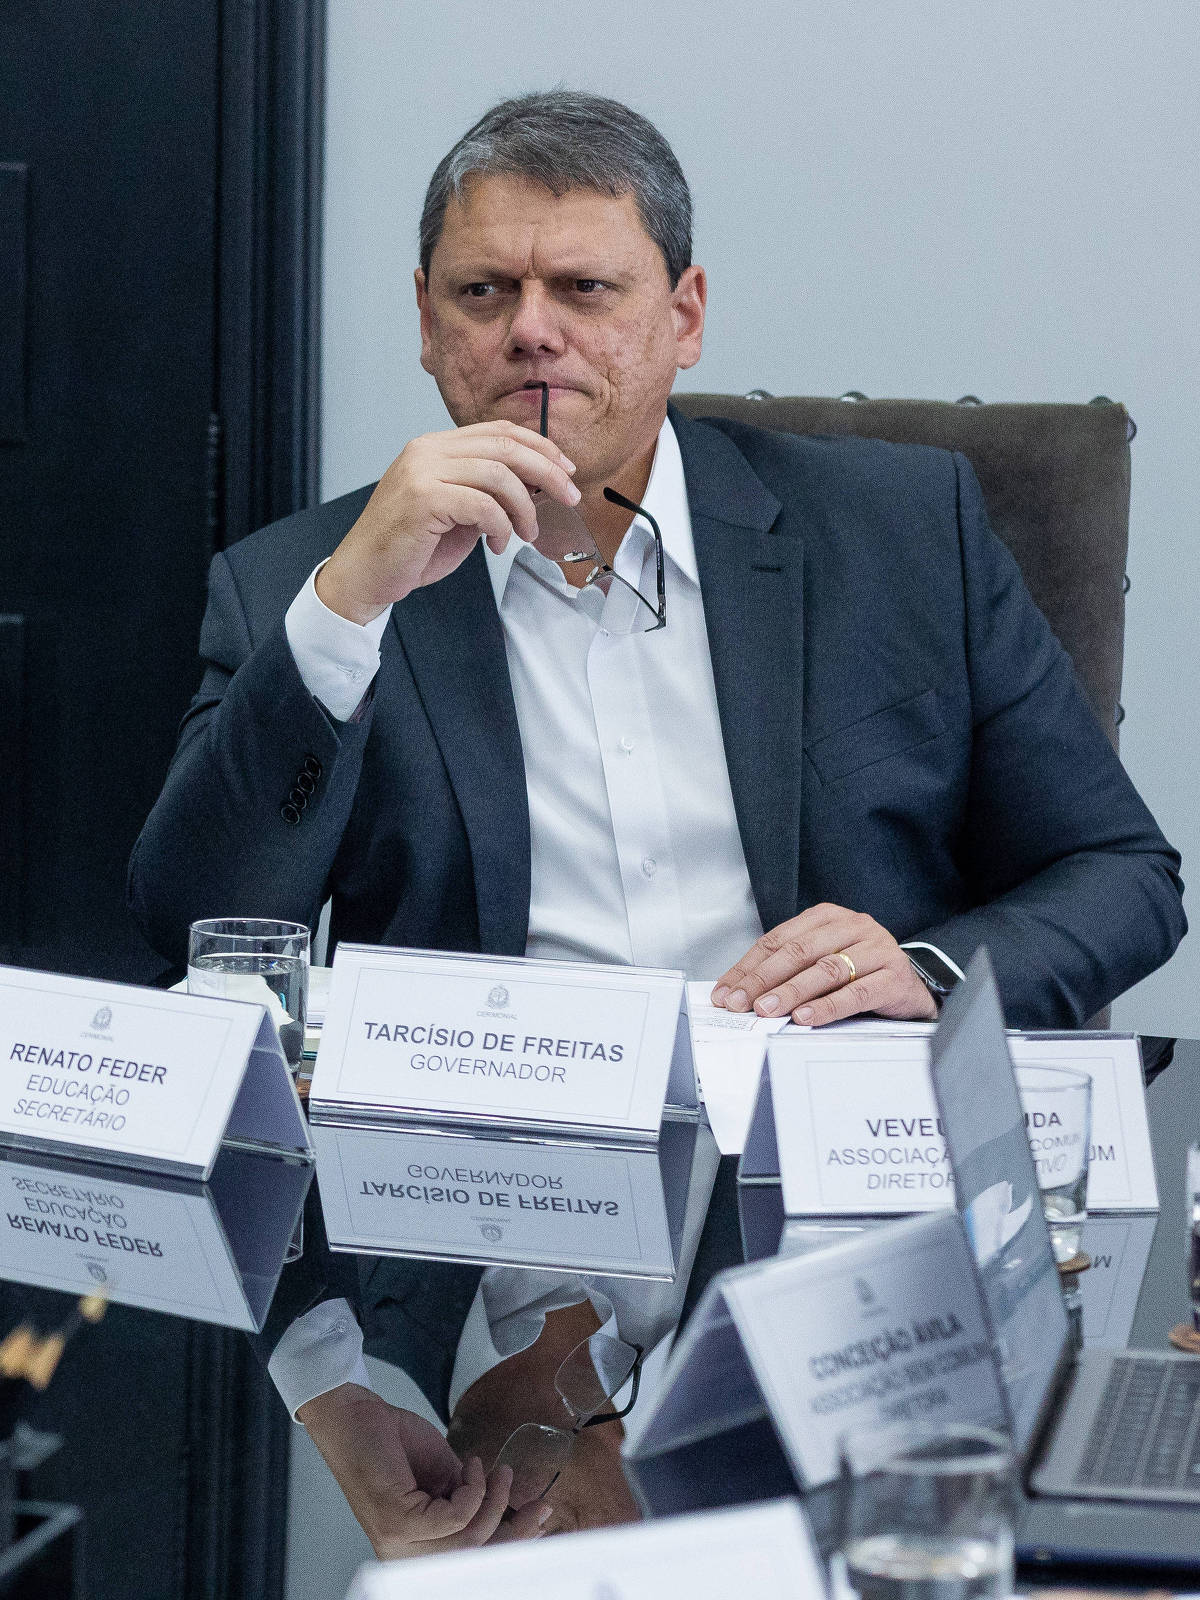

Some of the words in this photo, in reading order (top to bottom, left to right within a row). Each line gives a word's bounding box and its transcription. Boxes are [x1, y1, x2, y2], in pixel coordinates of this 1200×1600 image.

[364, 1022, 475, 1048] TARCÍSIO
[482, 1032, 515, 1052] DE
[522, 1036, 625, 1063] FREITAS
[9, 1042, 93, 1072] RENATO
[97, 1057, 168, 1085] FEDER
[410, 1053, 567, 1083] GOVERNADOR
[26, 1074, 130, 1106] EDUCAÇÃO
[13, 1098, 126, 1131] SECRETÁRIO
[827, 1147, 951, 1168] ASSOCIAÇ
